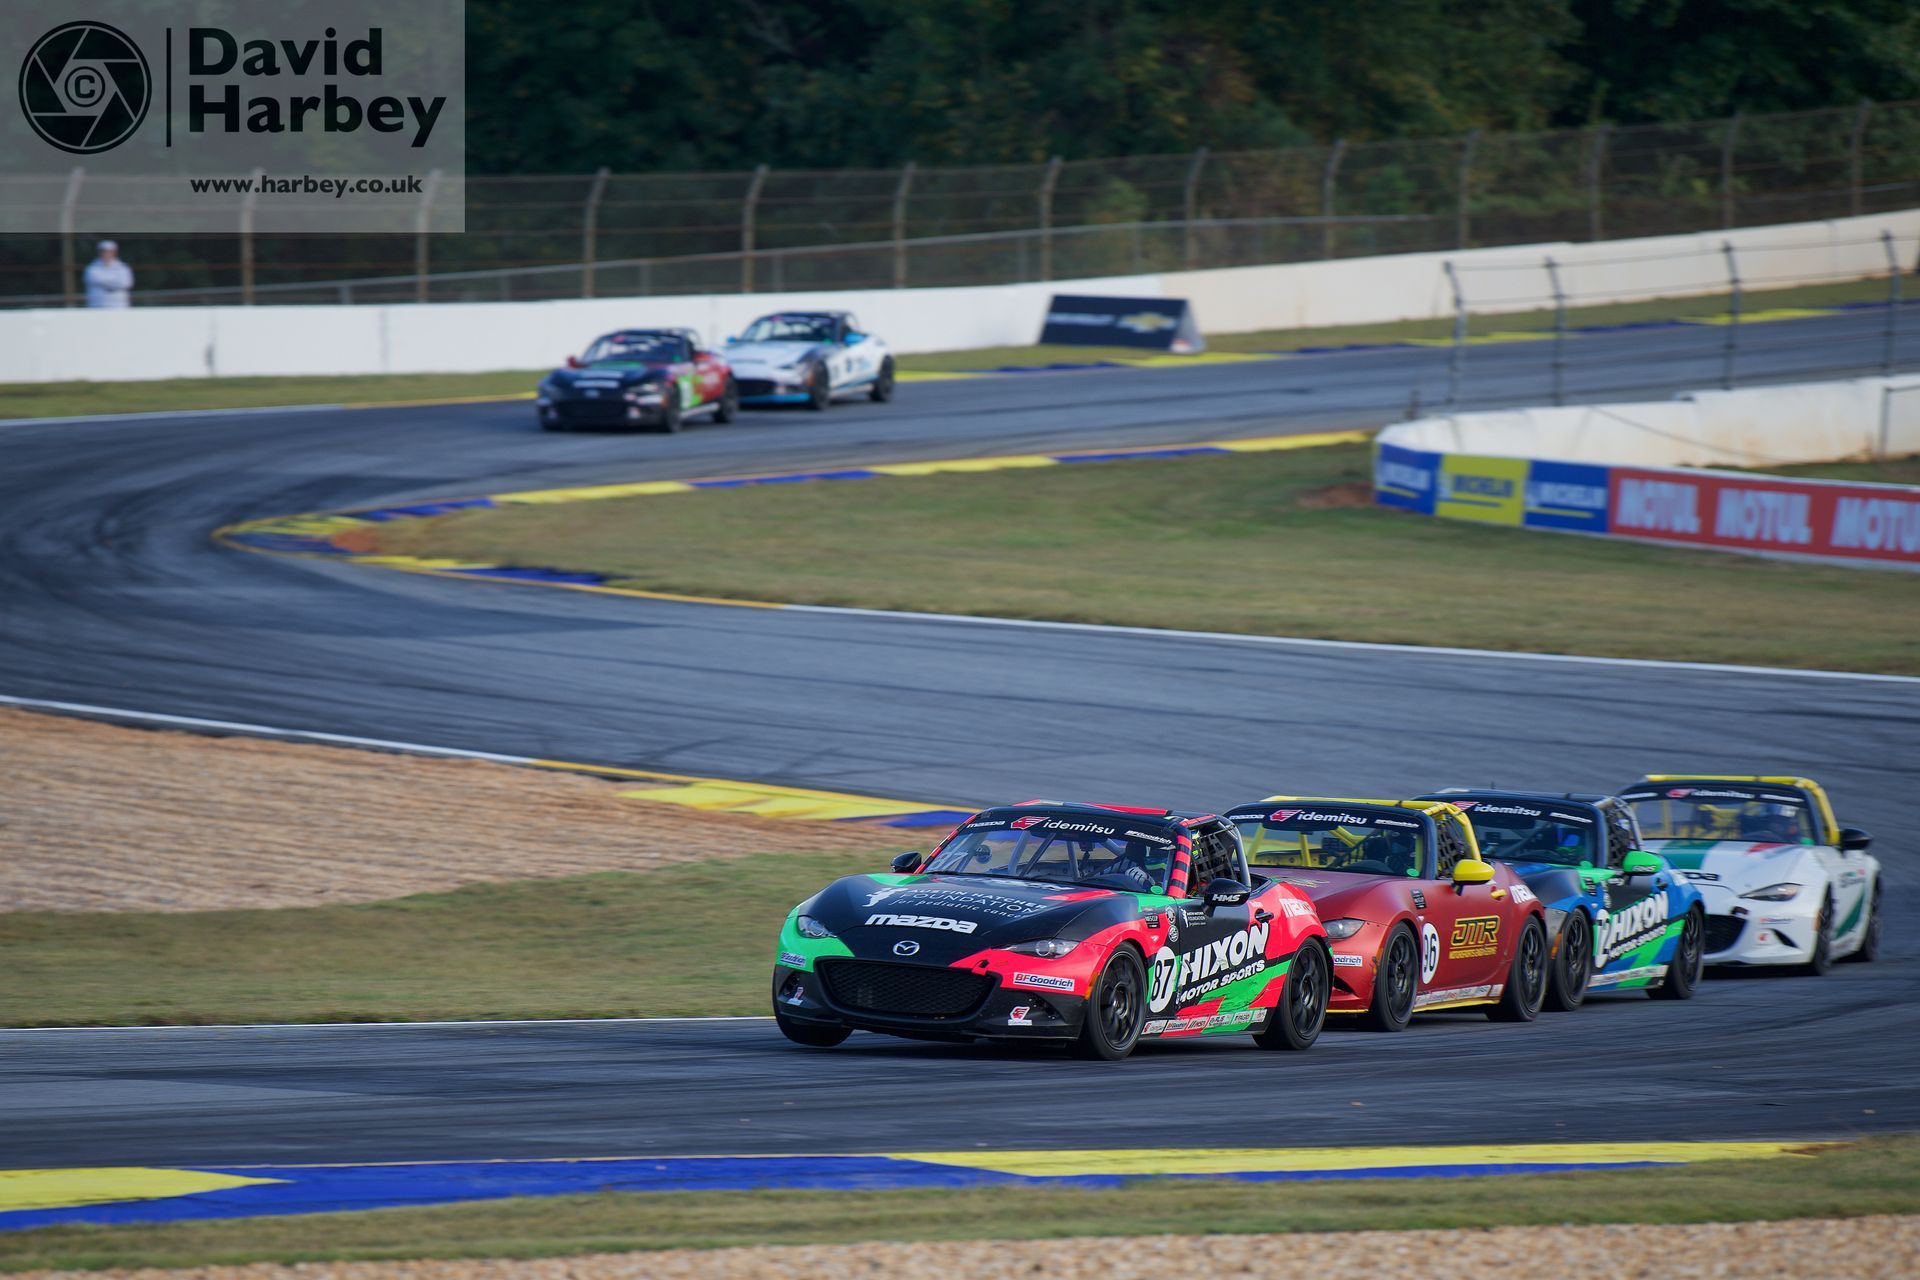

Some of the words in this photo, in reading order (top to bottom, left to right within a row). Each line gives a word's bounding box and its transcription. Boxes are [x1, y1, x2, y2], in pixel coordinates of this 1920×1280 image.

[1615, 478, 1701, 534] MOTUL
[1714, 488, 1813, 544] MOTUL
[1297, 811, 1367, 824] idemitsu
[1474, 804, 1542, 816] idemitsu
[1043, 819, 1115, 836] idemitsu
[899, 892, 1042, 914] FOUNDATION
[1212, 893, 1241, 903] HMS
[915, 899, 980, 911] pediatric
[983, 907, 1022, 918] cance
[1178, 921, 1269, 987] HIXON
[1015, 973, 1074, 987] BFGoodrich
[1151, 957, 1175, 1002] 87
[1176, 979, 1220, 1004] MOTOR
[1220, 960, 1266, 986] SPORTS
